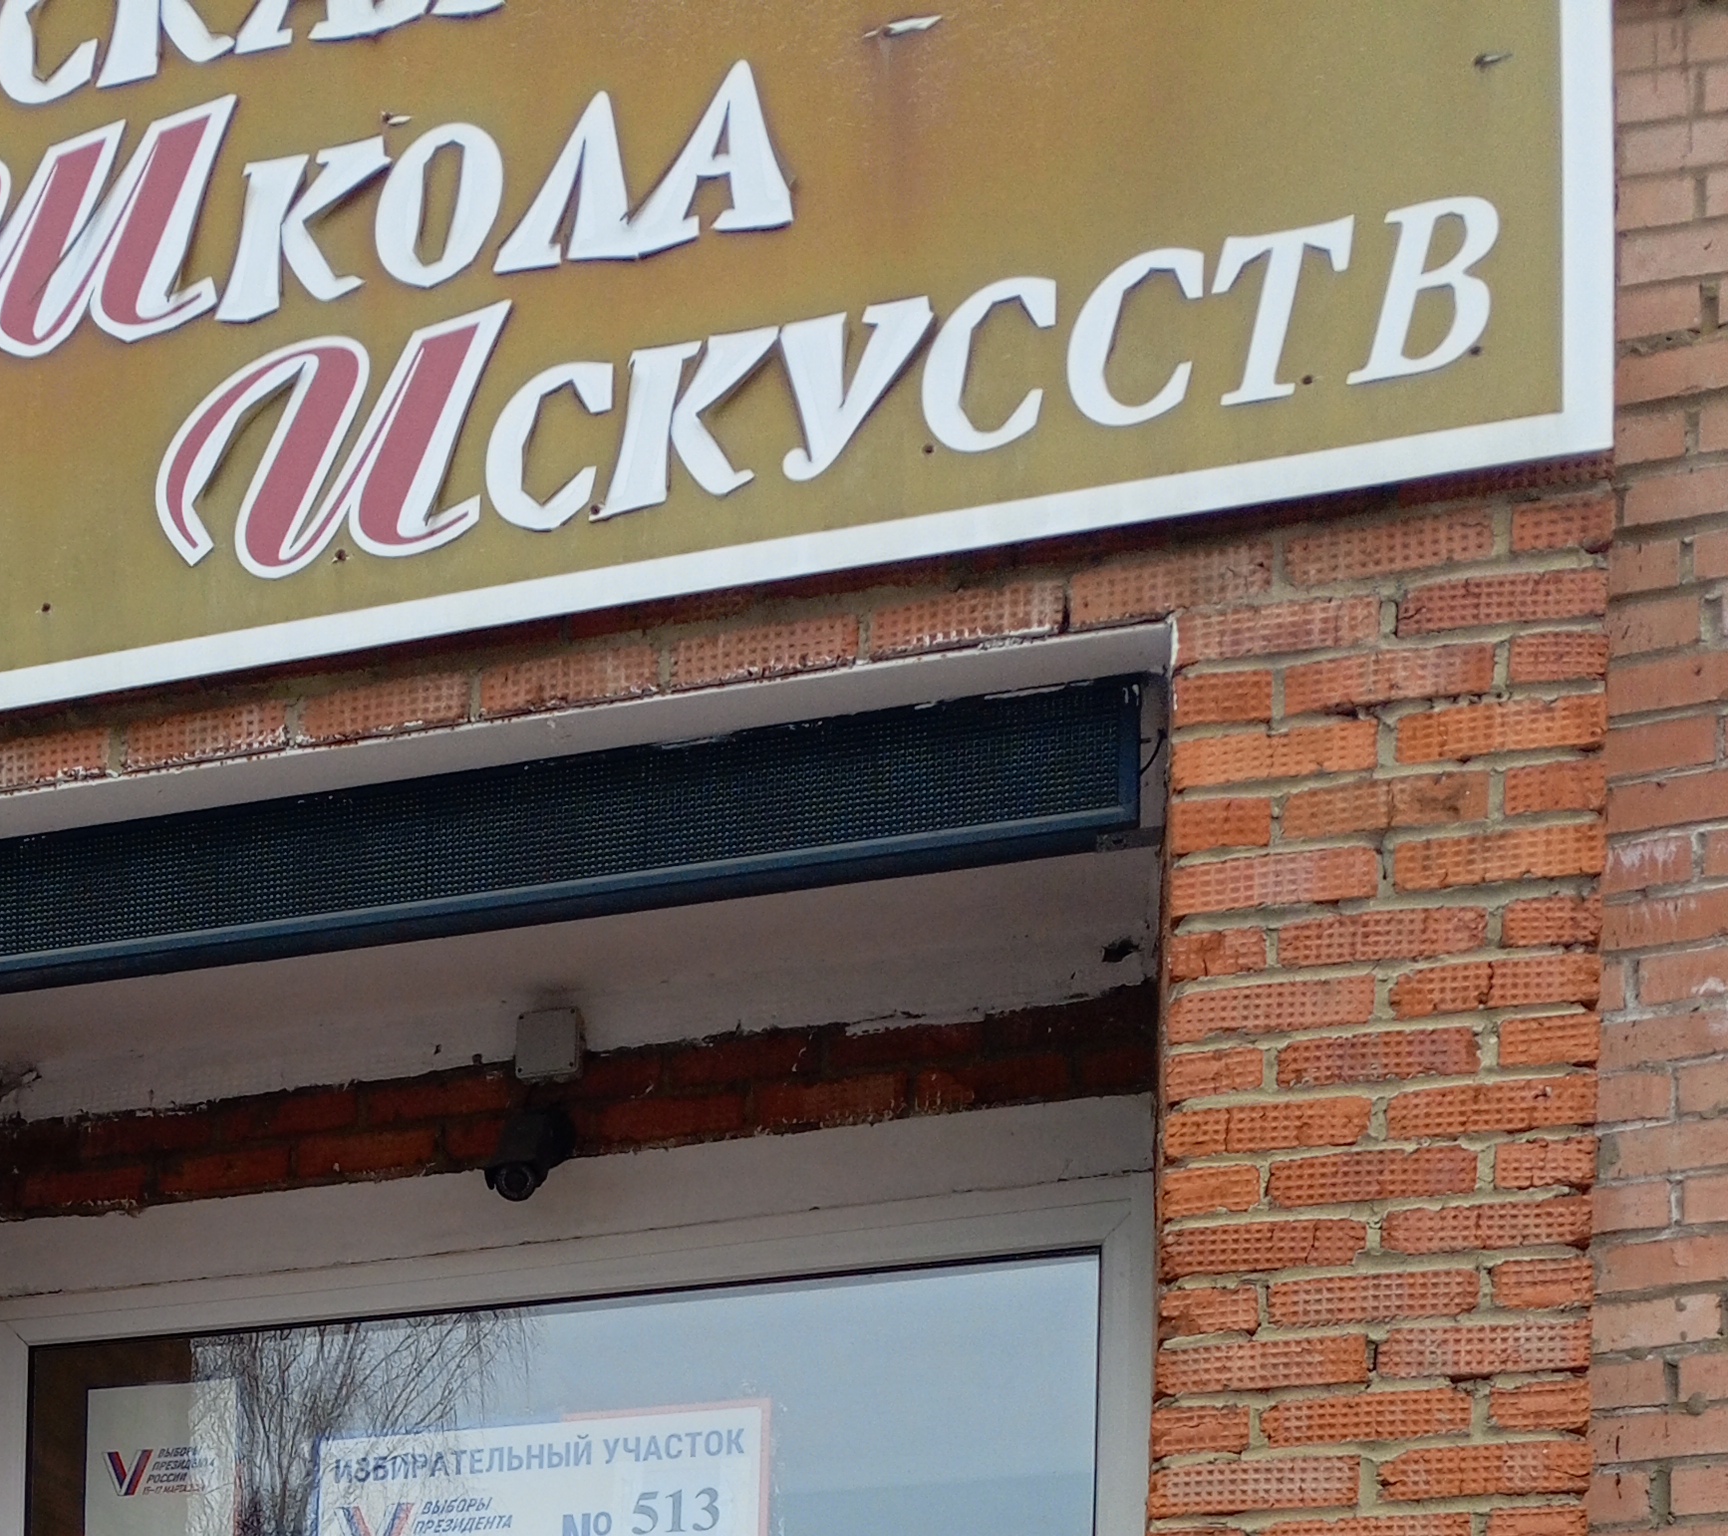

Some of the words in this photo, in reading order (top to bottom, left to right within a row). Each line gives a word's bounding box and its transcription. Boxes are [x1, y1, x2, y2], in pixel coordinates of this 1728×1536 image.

[157, 1446, 202, 1459] ВЫБОРЫ
[333, 1434, 593, 1485] ИЗБИРАТЕЛЬНЫЙ
[602, 1428, 745, 1465] УЧАСТОК
[146, 1471, 188, 1484] РОССИИ
[422, 1497, 493, 1516] ВЫБОРЫ
[632, 1487, 720, 1535] 513
[413, 1514, 513, 1535] ПРЕЗИДЕНТА
